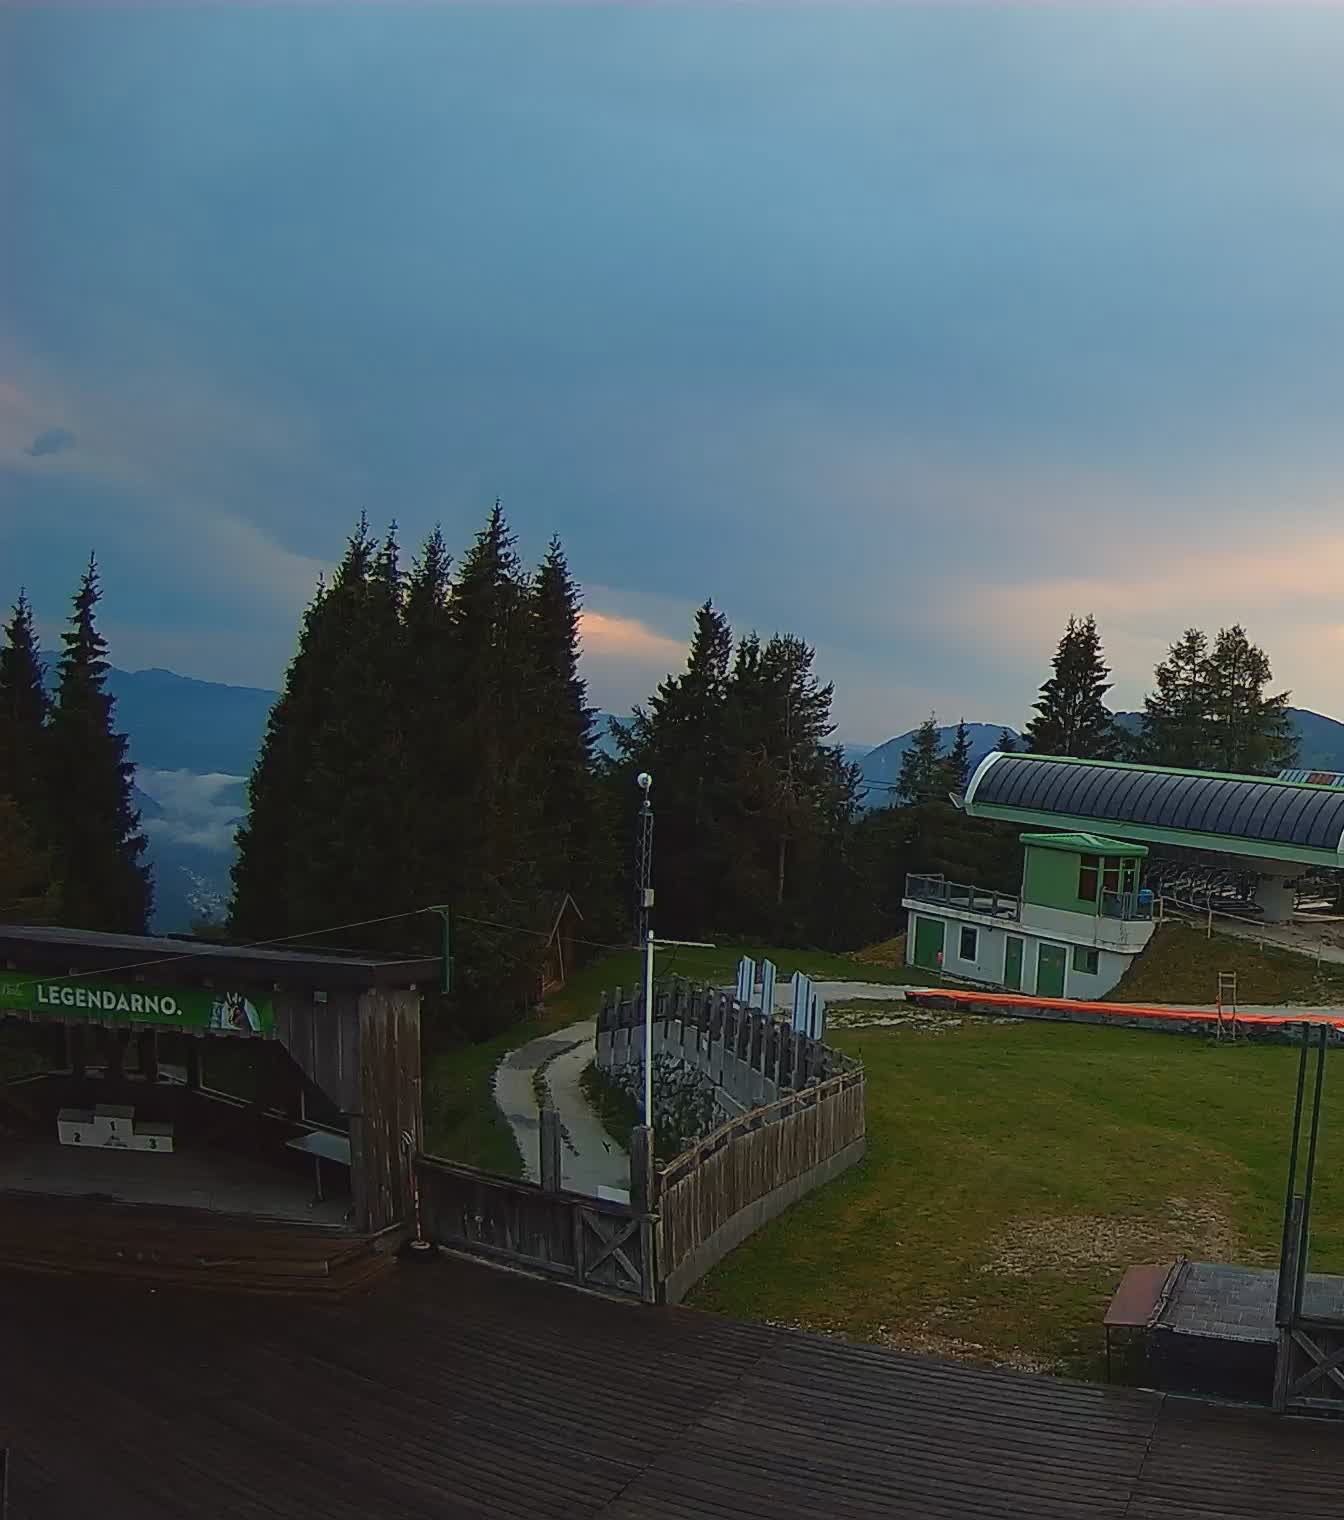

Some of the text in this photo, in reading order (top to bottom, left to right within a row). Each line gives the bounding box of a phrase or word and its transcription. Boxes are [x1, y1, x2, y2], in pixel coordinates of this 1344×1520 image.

[37, 984, 183, 1015] LEGENDARNO.
[110, 1121, 115, 1131] 1
[74, 1132, 81, 1142] 2
[149, 1139, 157, 1149] 3
